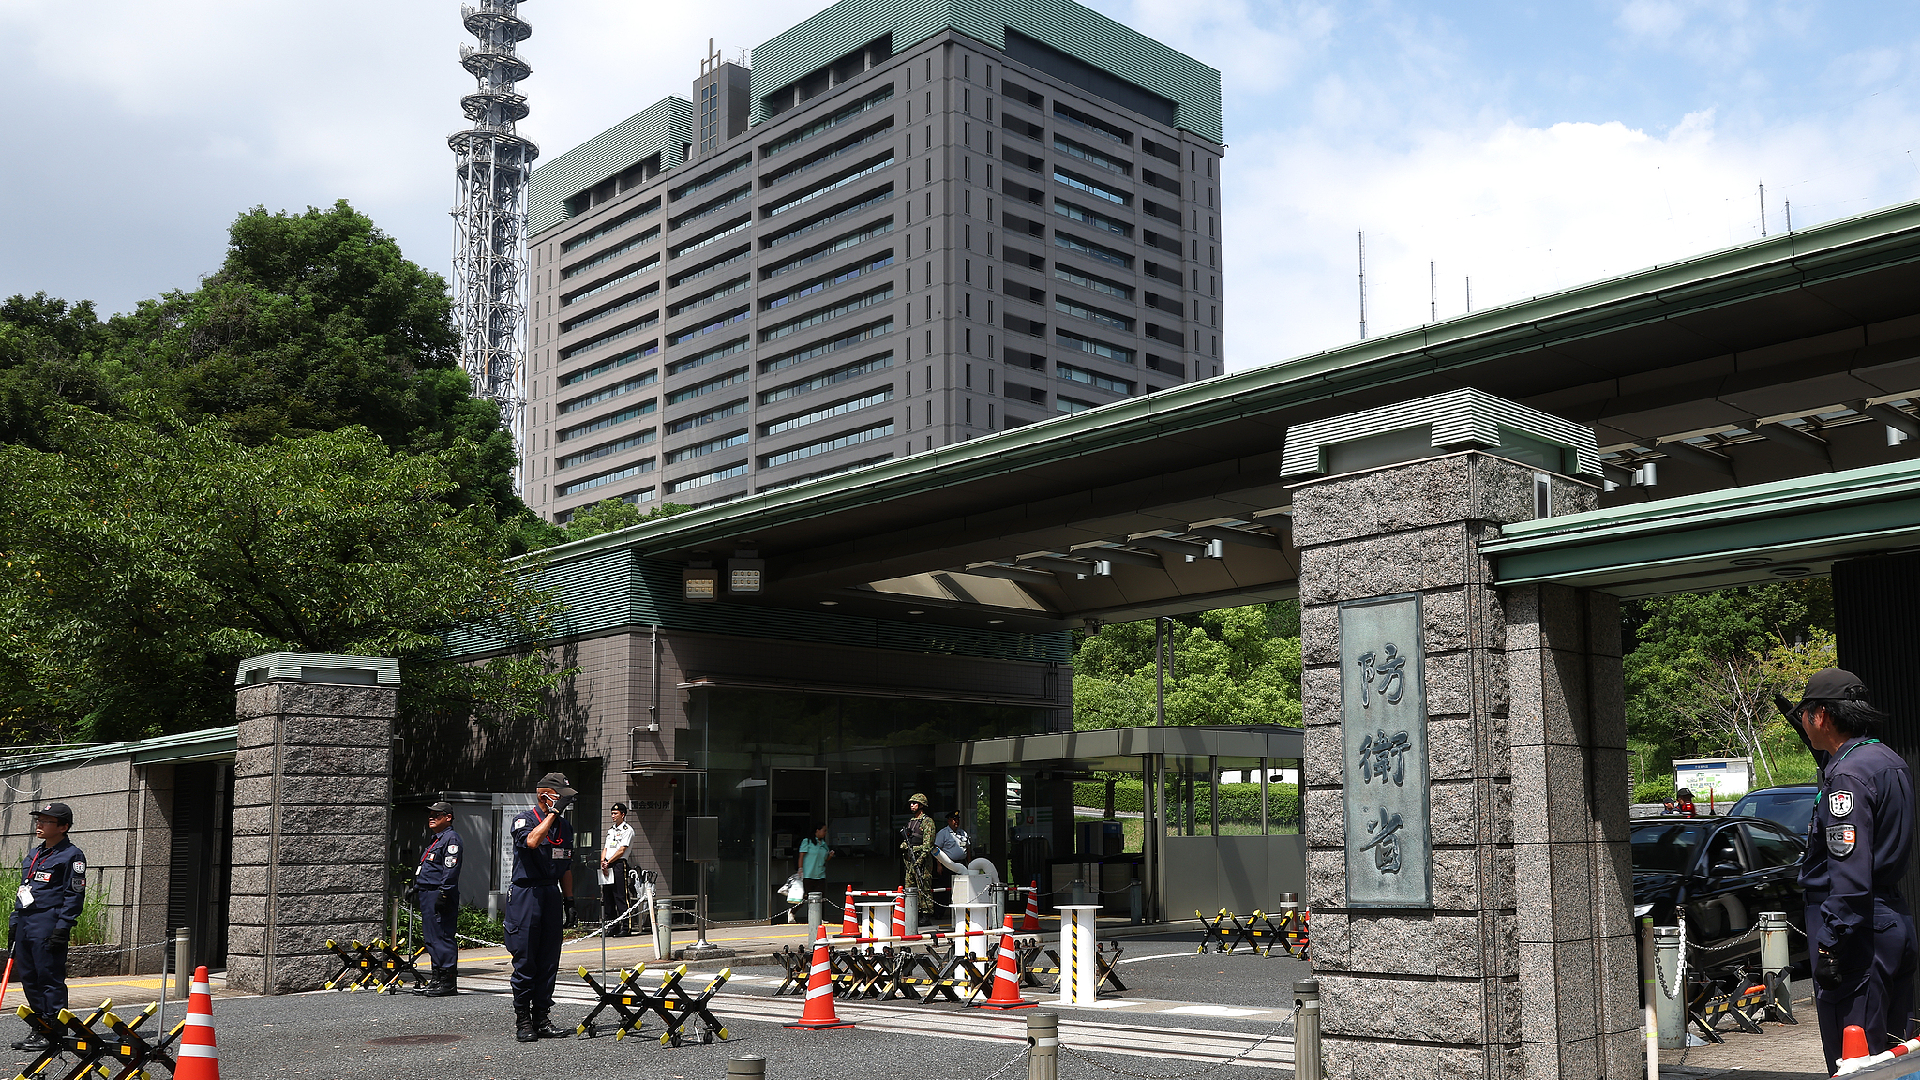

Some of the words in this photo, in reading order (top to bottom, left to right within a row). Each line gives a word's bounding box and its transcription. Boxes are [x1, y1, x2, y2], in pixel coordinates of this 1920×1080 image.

[1358, 643, 1412, 874] 防衛省
[1829, 832, 1854, 841] KSS
